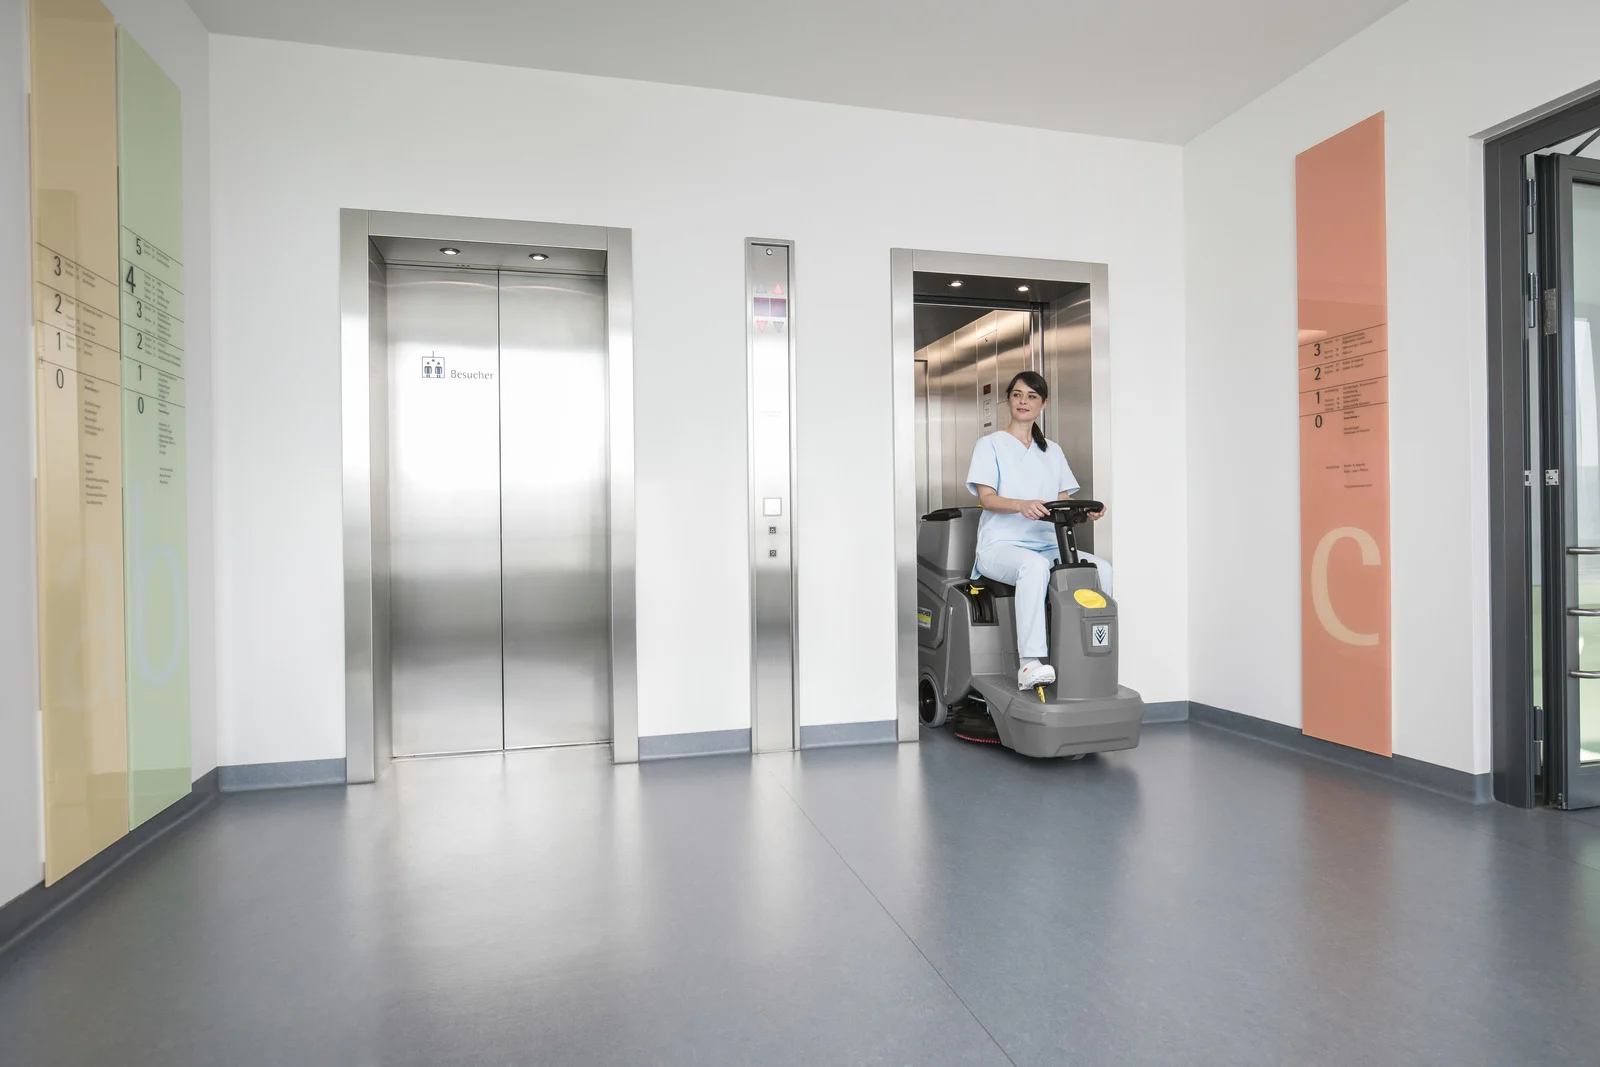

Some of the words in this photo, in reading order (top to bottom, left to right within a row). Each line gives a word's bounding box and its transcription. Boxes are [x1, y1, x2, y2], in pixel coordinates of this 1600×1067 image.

[135, 237, 142, 255] 5
[54, 255, 62, 276] 3
[126, 266, 136, 294] 4
[54, 293, 62, 314] 2
[136, 301, 143, 318] 3
[56, 332, 61, 350] 1
[137, 332, 143, 350] 2
[1314, 343, 1321, 357] 3
[56, 368, 64, 389] 0
[138, 365, 142, 381] 1
[451, 369, 494, 380] Besucher
[1314, 367, 1321, 381] 2
[137, 396, 144, 414] 0
[1315, 391, 1320, 404] 1
[1314, 415, 1323, 429] 0
